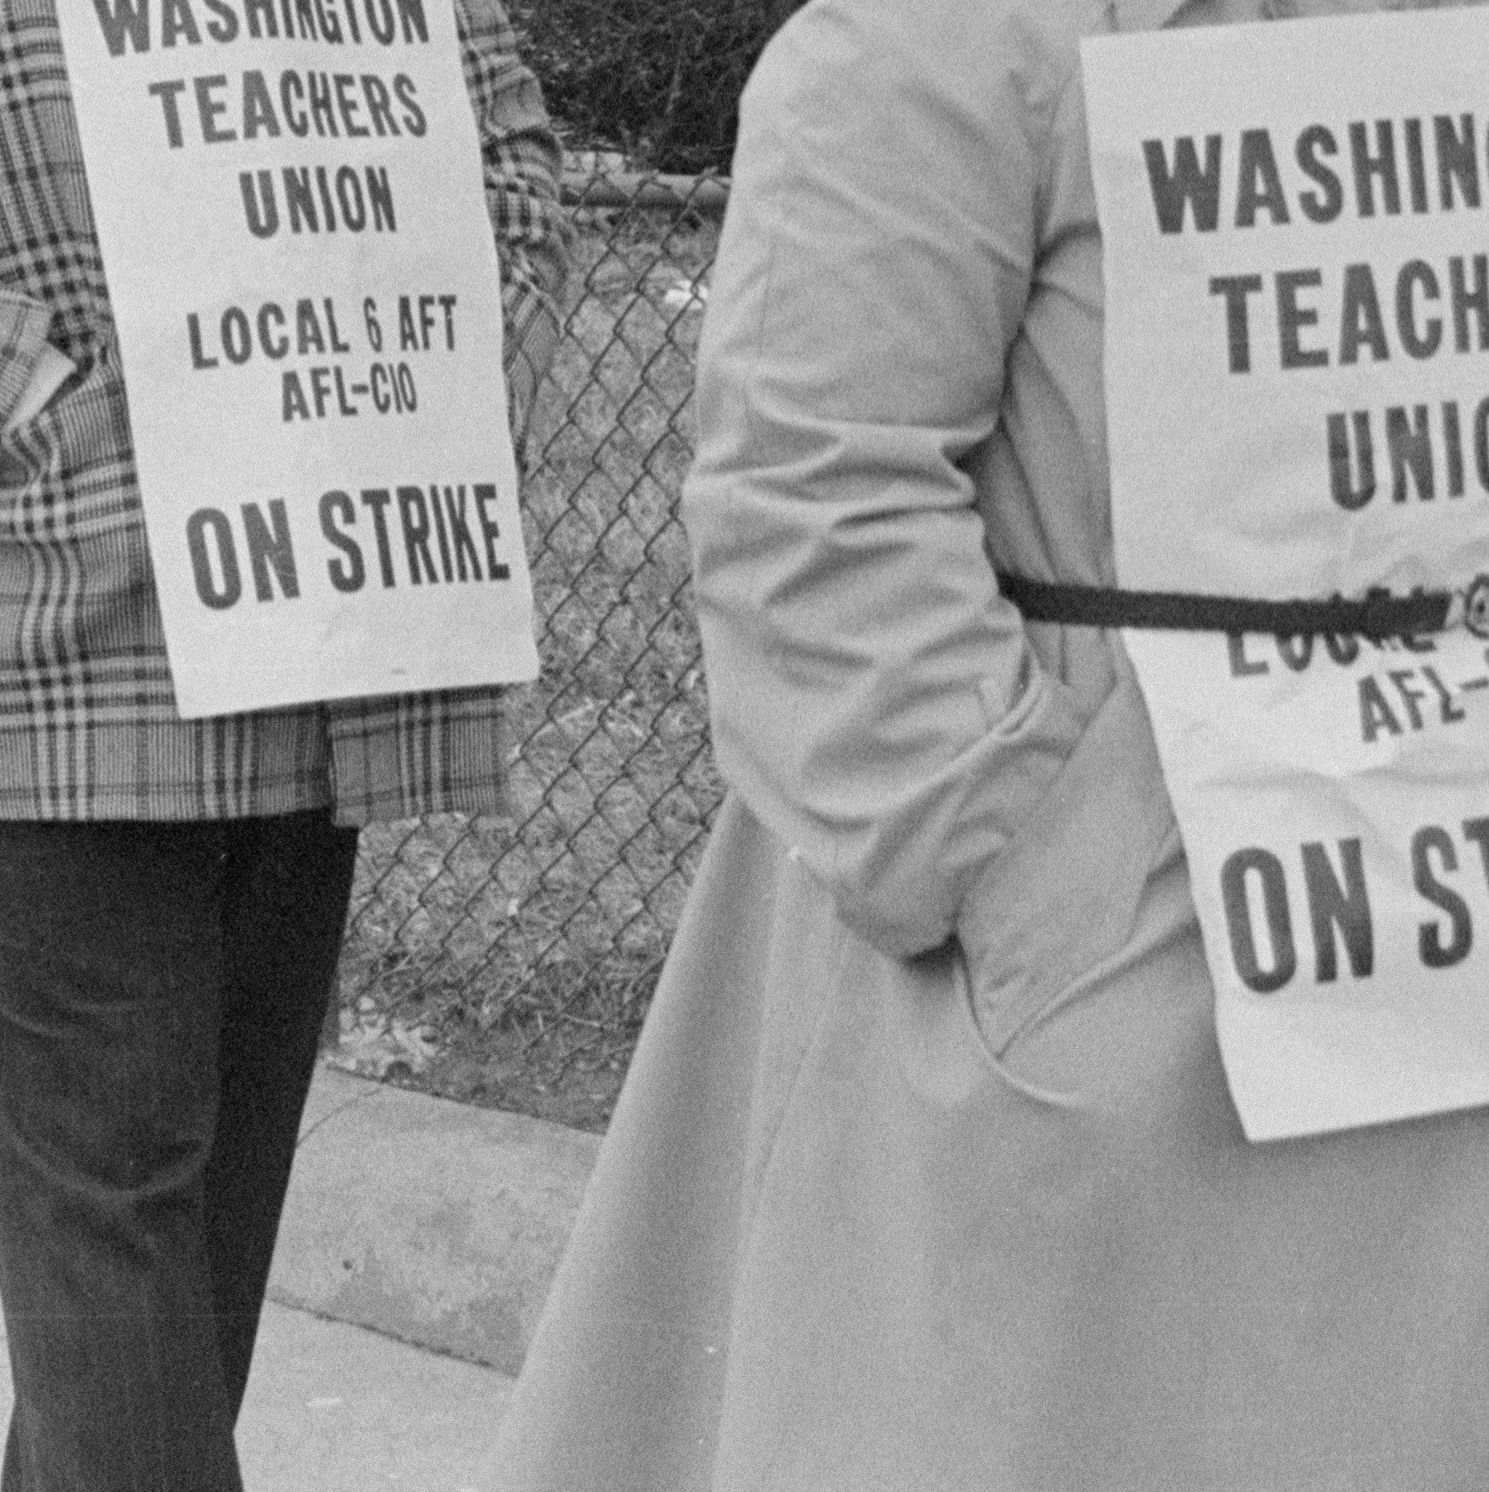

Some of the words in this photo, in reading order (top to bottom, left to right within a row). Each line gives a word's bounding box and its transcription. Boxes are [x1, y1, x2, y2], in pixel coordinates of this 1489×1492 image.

[147, 68, 427, 149] TEACHERS
[238, 164, 397, 239] UNION
[1140, 112, 1489, 235] WASHIN
[186, 296, 351, 370] LOCAL
[363, 295, 384, 353] 6
[398, 294, 457, 352] AFT
[1207, 253, 1489, 375] TEACH
[281, 361, 419, 422] AFL-CIO
[185, 497, 302, 611] ON
[317, 482, 512, 594] STRIKE
[1220, 836, 1376, 994] ON
